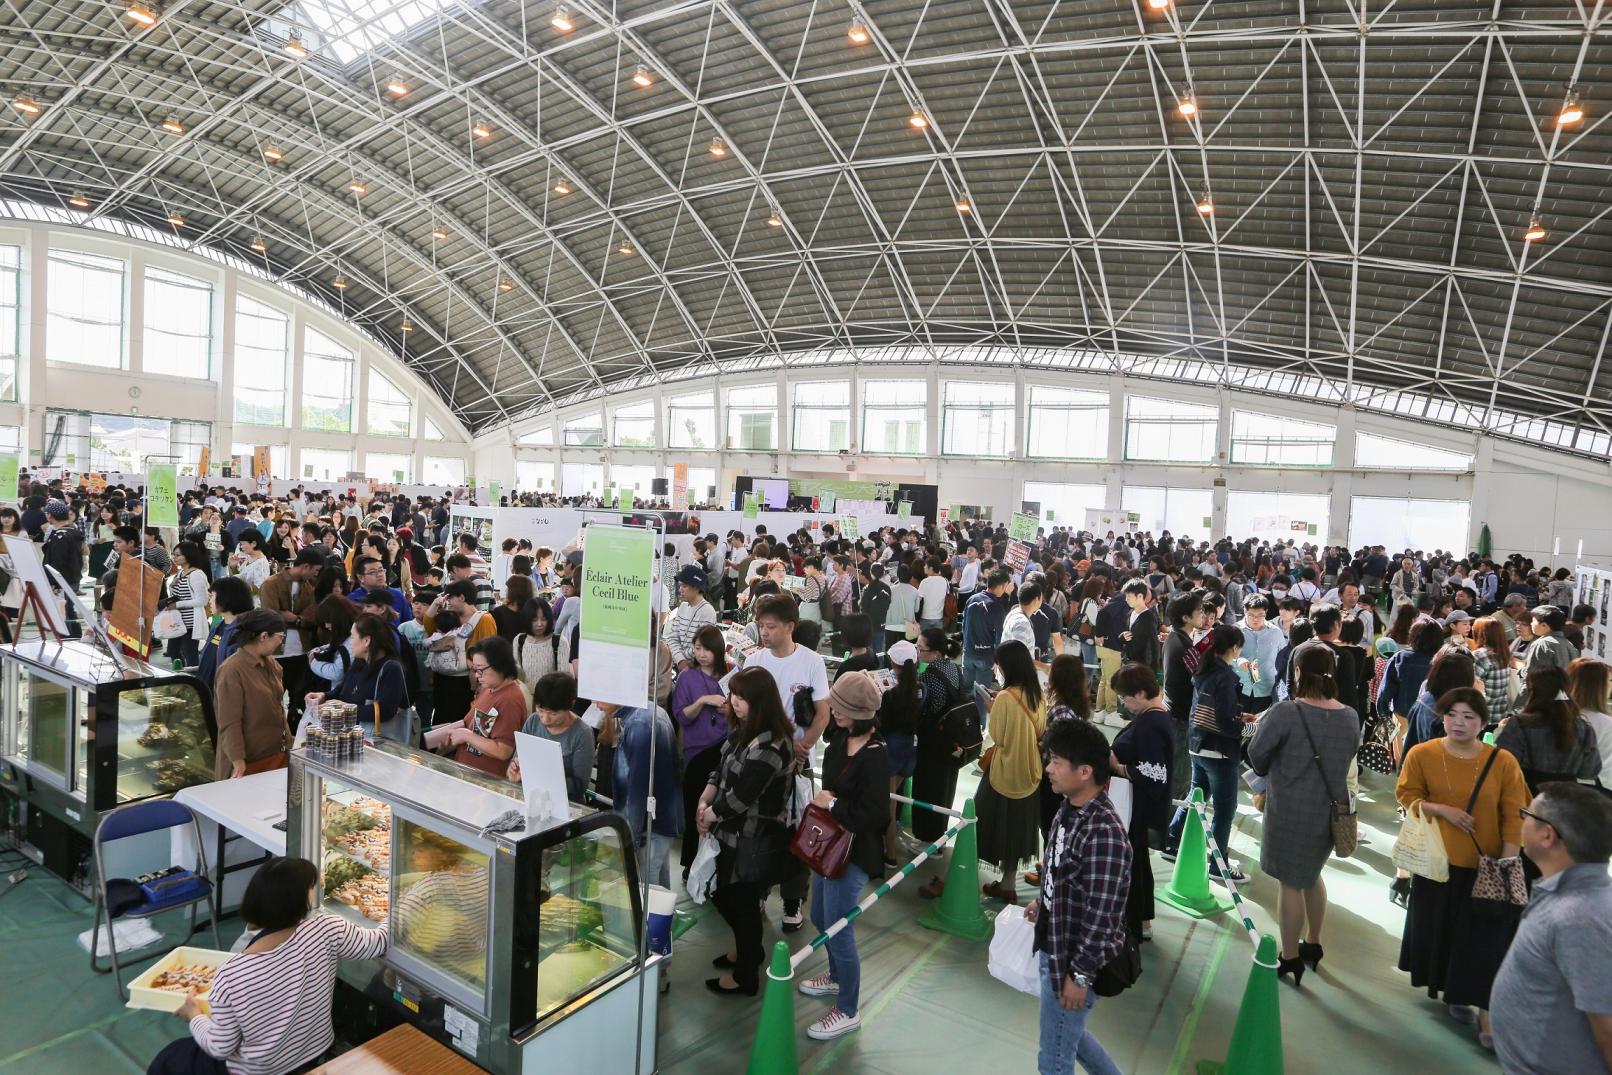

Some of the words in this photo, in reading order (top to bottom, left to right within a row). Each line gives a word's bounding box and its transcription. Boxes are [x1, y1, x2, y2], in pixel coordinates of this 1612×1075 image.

[586, 567, 612, 583] Éclair
[615, 573, 648, 587] Atelier
[592, 585, 614, 599] Cecil
[617, 588, 640, 602] Blue
